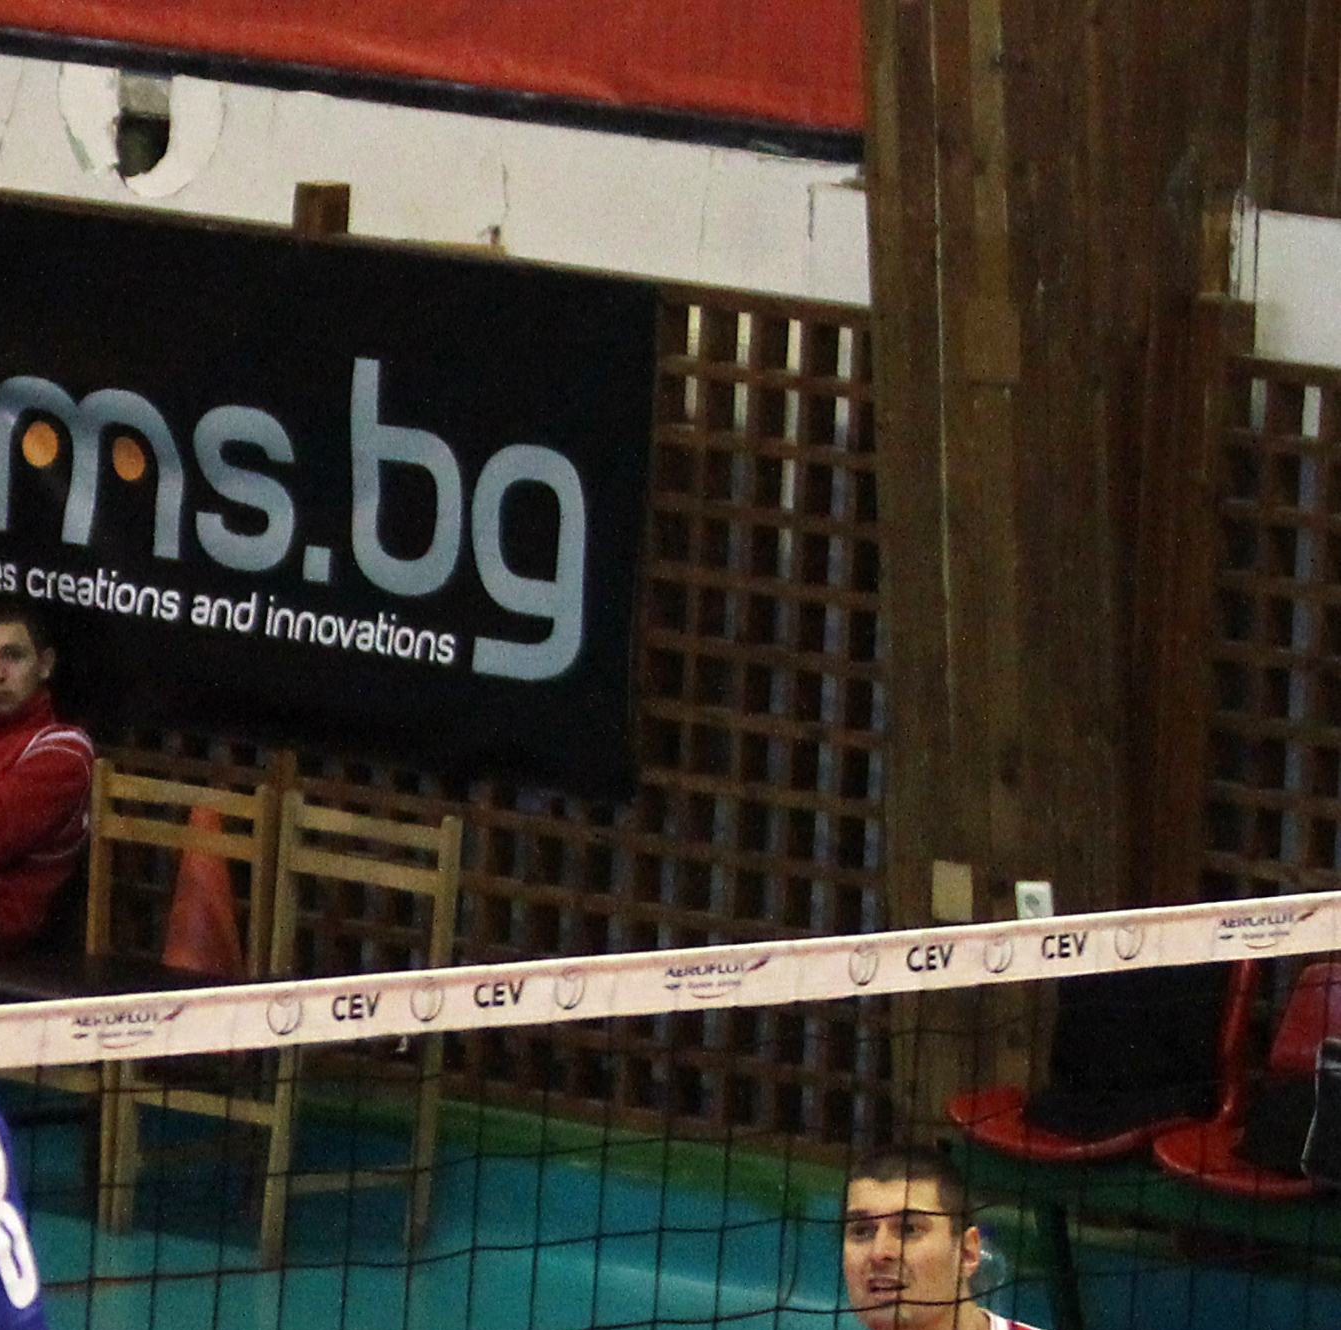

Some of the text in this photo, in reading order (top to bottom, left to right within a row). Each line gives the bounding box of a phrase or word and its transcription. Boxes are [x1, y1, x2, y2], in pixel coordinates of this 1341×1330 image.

[26, 568, 181, 621] creations
[191, 592, 258, 632] and
[265, 596, 456, 665] innovations
[907, 942, 955, 972] CEV
[1041, 930, 1089, 960] CEV
[332, 990, 381, 1021] CEV
[474, 978, 526, 1009] CEV
